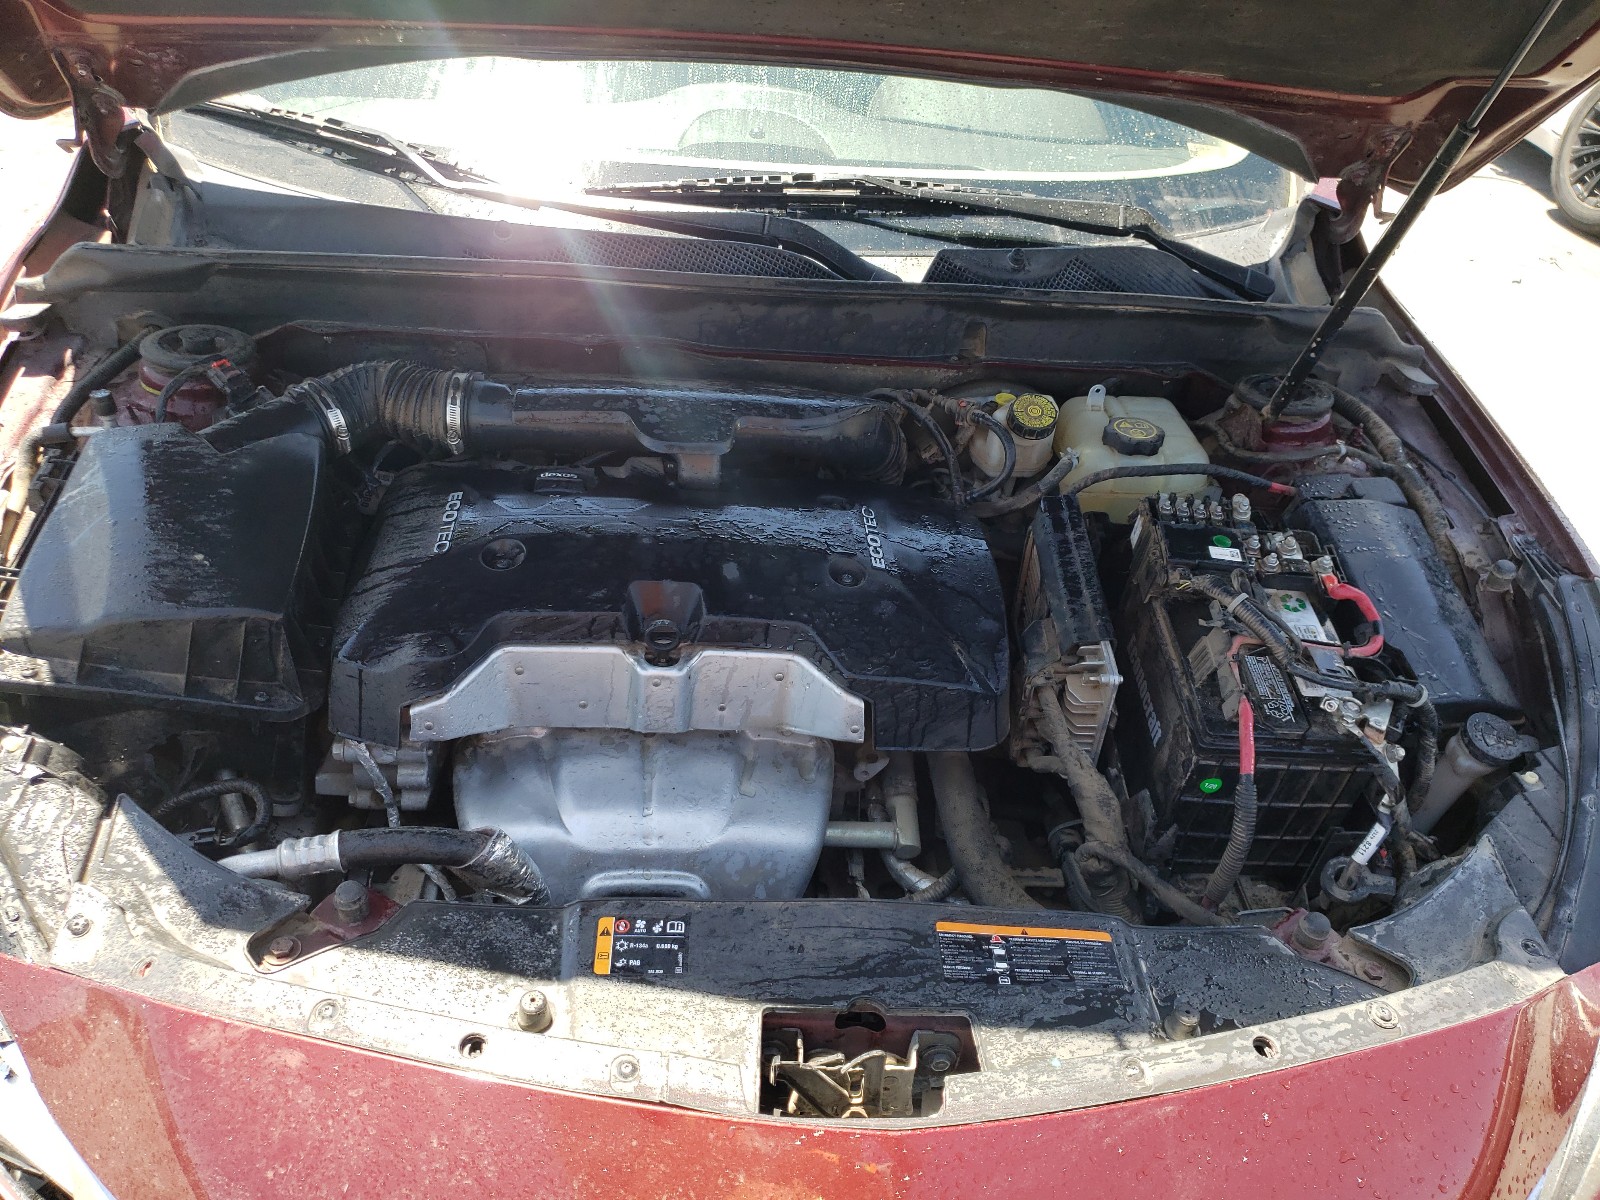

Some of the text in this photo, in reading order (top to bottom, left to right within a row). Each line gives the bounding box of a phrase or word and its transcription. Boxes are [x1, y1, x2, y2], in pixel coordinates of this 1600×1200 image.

[434, 491, 464, 553] ECOTEC
[862, 505, 886, 569] ECOTEC
[1358, 840, 1372, 856] 8211
